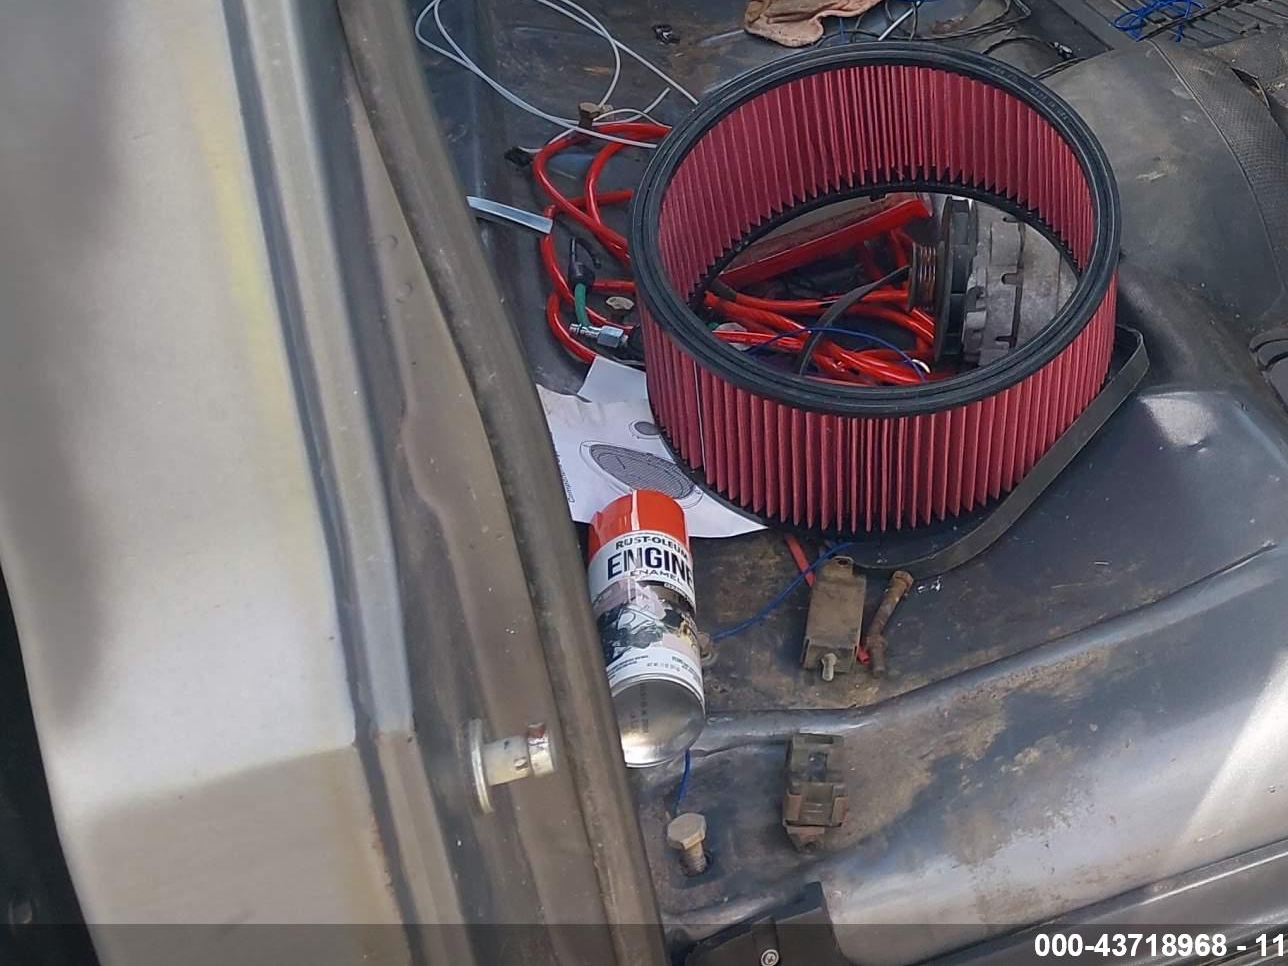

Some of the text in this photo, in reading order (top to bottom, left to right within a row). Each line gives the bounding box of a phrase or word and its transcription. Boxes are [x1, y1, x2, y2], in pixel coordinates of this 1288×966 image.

[615, 535, 688, 559] RUST-OLEUM
[607, 546, 694, 594] ENGINE
[630, 568, 684, 586] ENAMEL
